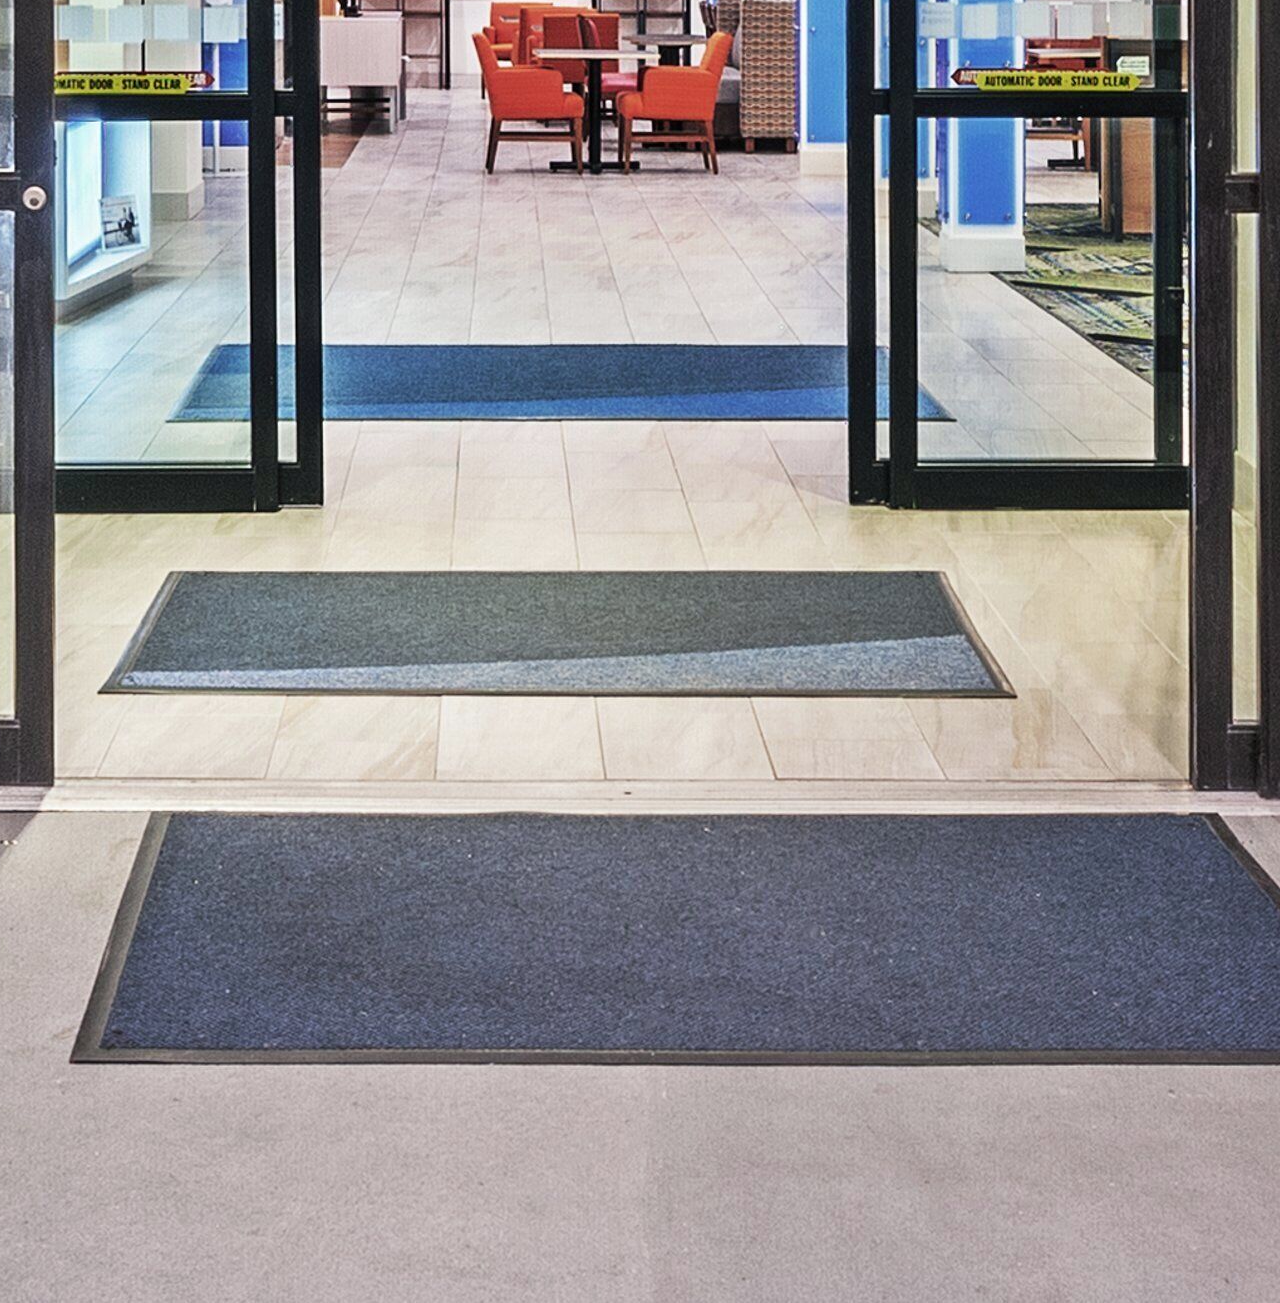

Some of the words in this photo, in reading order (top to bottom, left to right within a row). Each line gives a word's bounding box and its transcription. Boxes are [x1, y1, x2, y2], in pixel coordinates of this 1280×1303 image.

[89, 79, 114, 90] DOOR
[122, 79, 150, 90] STAND
[153, 78, 181, 89] CLEAR
[984, 76, 1035, 87] AUTOMATIC
[1038, 76, 1062, 87] DOOR
[1071, 76, 1099, 87] STAND
[1103, 76, 1130, 87] CLEAR
